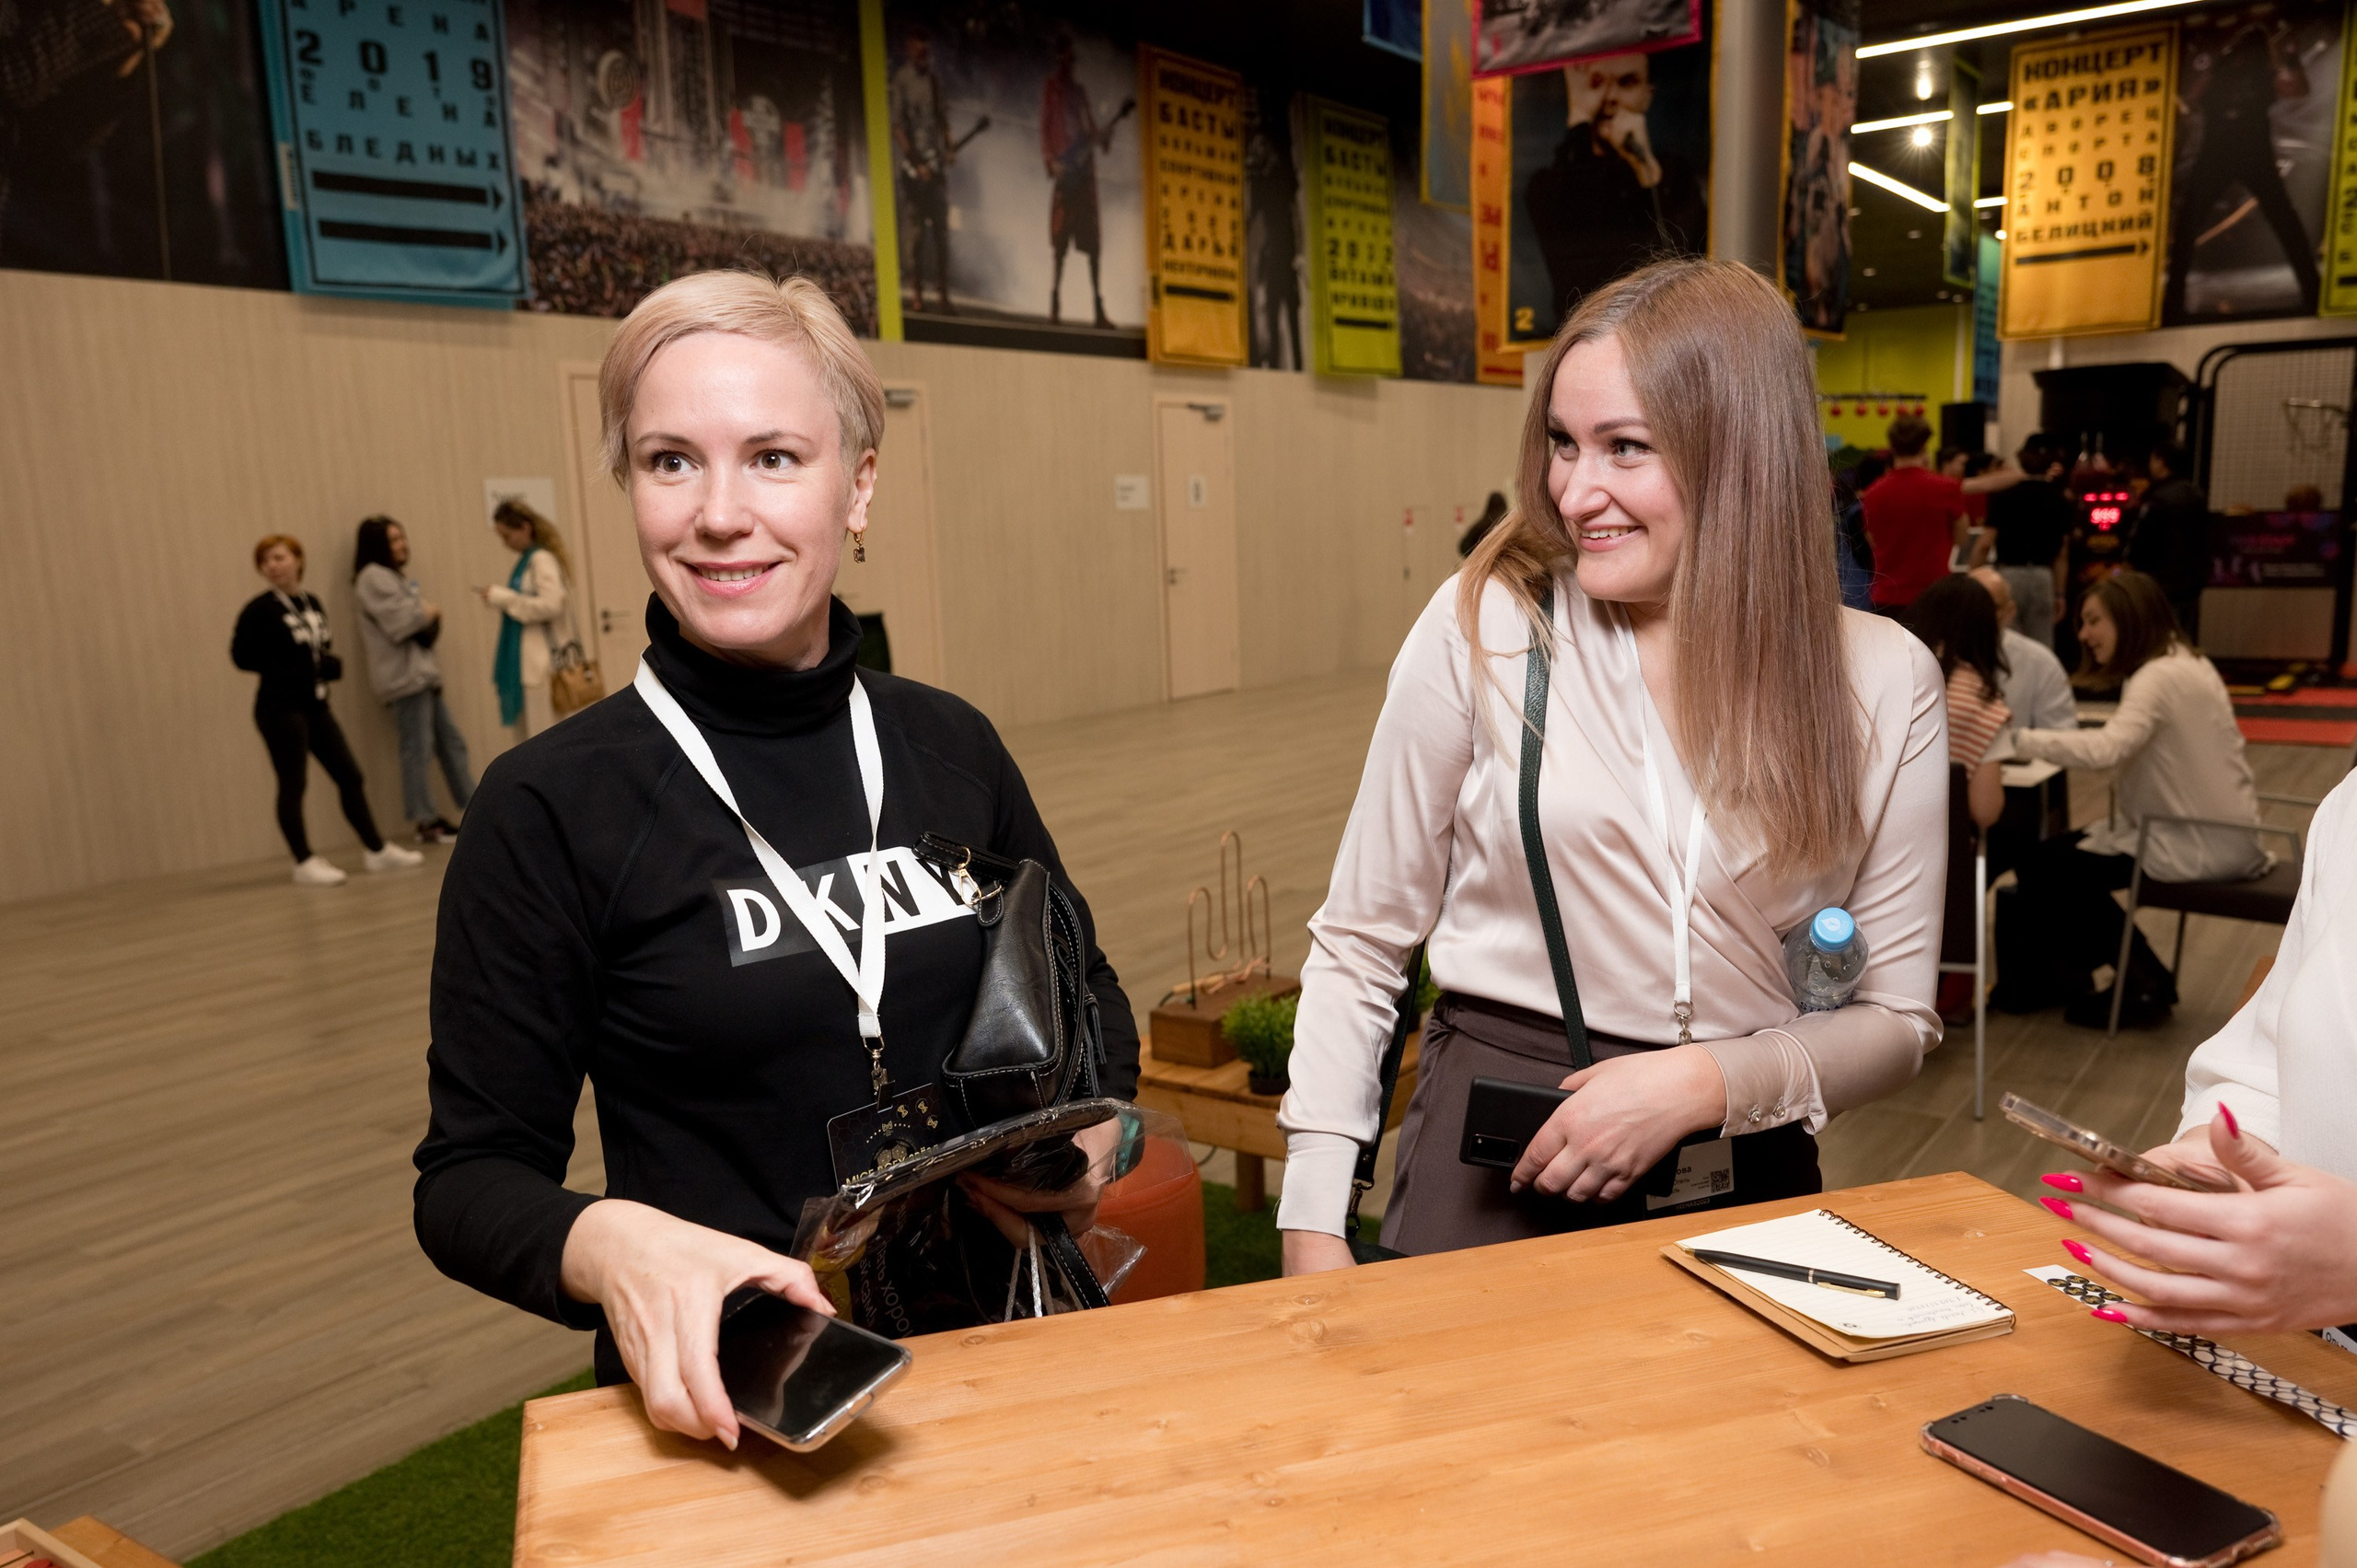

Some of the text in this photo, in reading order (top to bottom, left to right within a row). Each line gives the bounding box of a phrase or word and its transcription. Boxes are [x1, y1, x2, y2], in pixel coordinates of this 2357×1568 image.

[295, 29, 494, 90] 2019
[2025, 42, 2162, 82] КОНЦЕРТ
[301, 82, 498, 129] ЕЛЕНА
[305, 129, 502, 172] БЛЕДНЫХ
[2019, 155, 2155, 191] 2008
[2017, 187, 2154, 216] АНТОН
[1515, 307, 1534, 331] 2
[726, 858, 967, 952] DKNY
[880, 1280, 914, 1337] хоро
